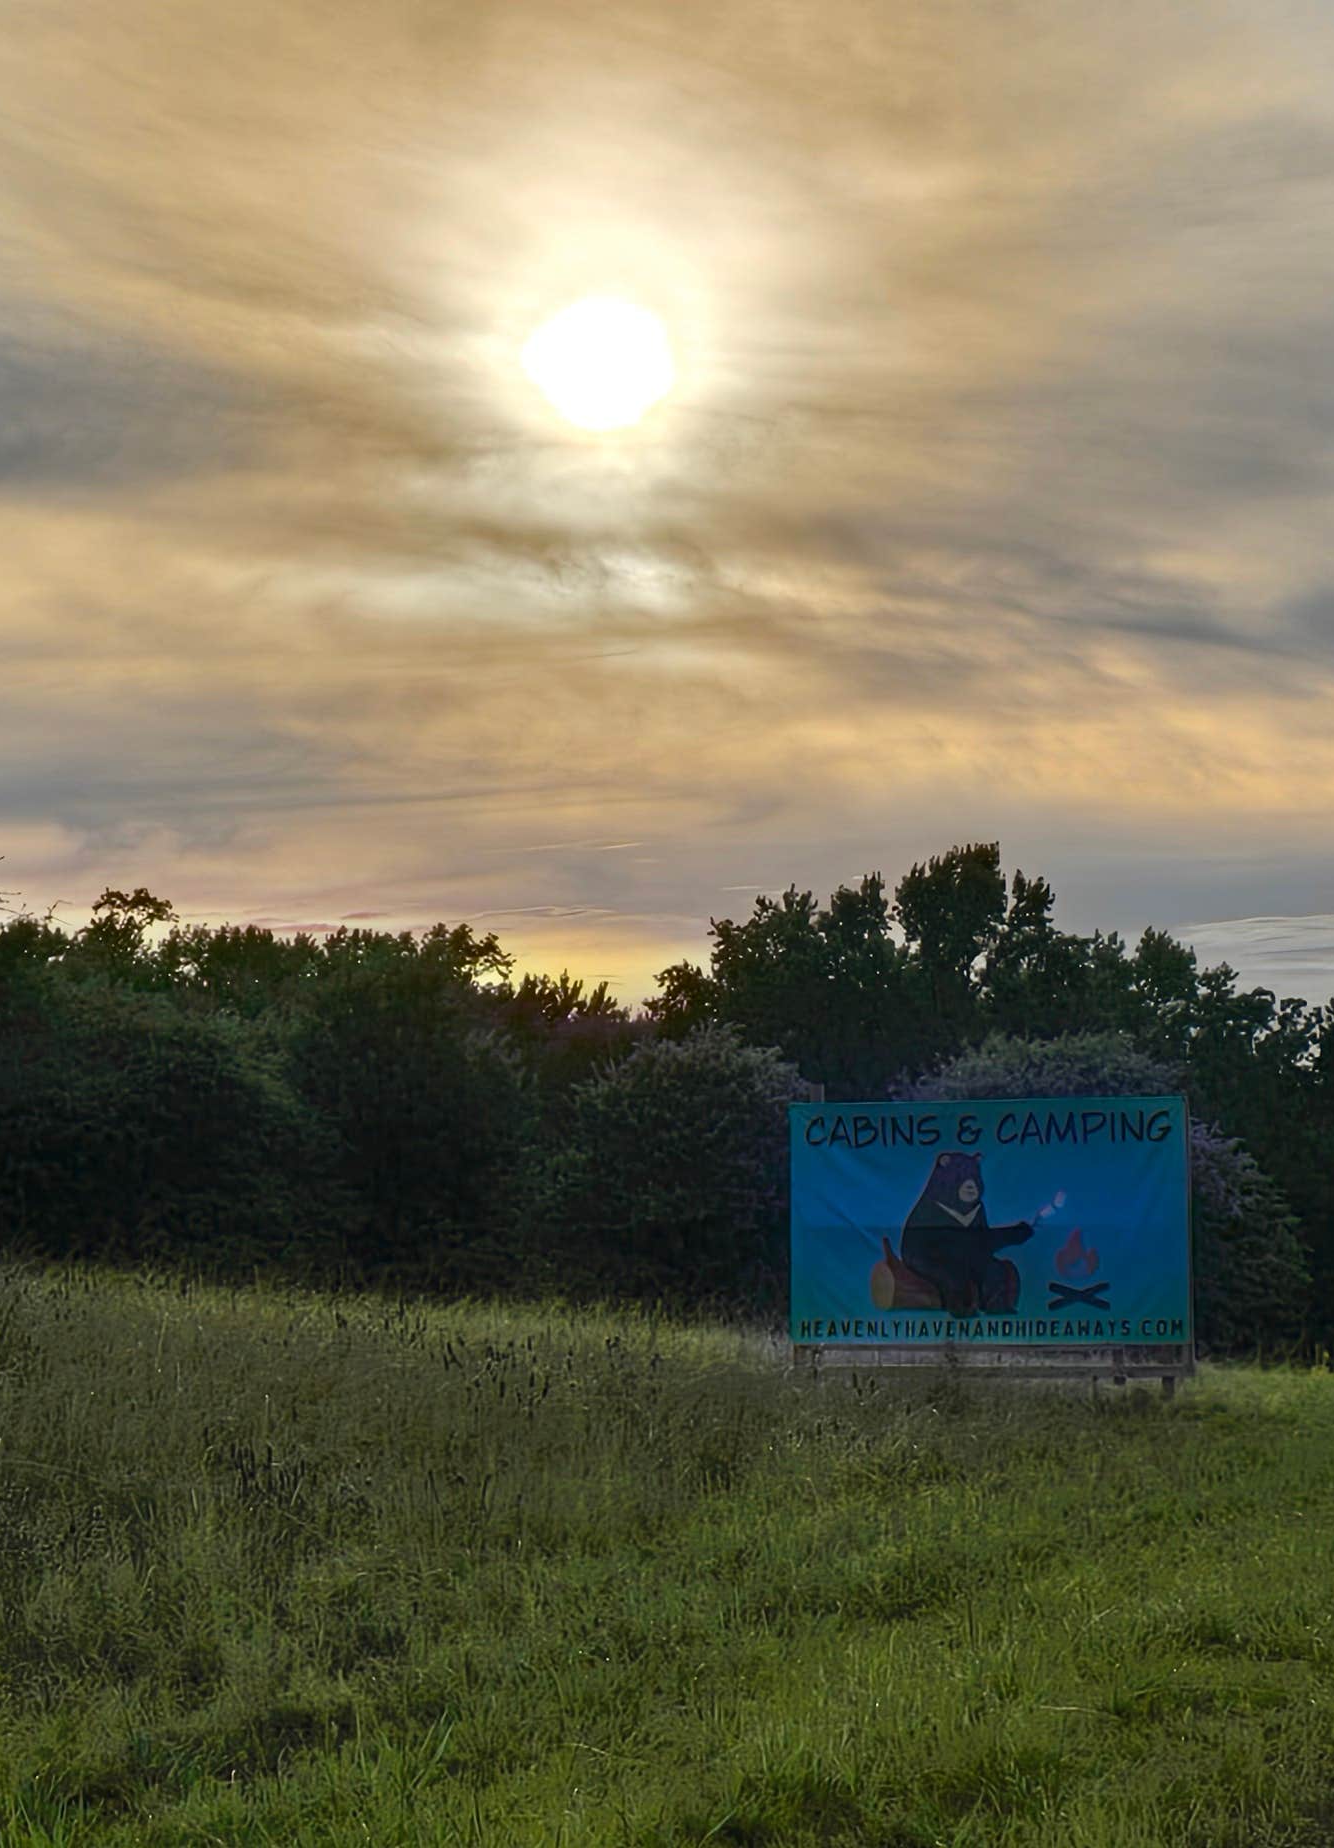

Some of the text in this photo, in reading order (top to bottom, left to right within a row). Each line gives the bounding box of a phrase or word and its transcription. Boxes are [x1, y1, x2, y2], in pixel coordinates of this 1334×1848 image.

[805, 1110, 1172, 1147] CABINS & CAMPING
